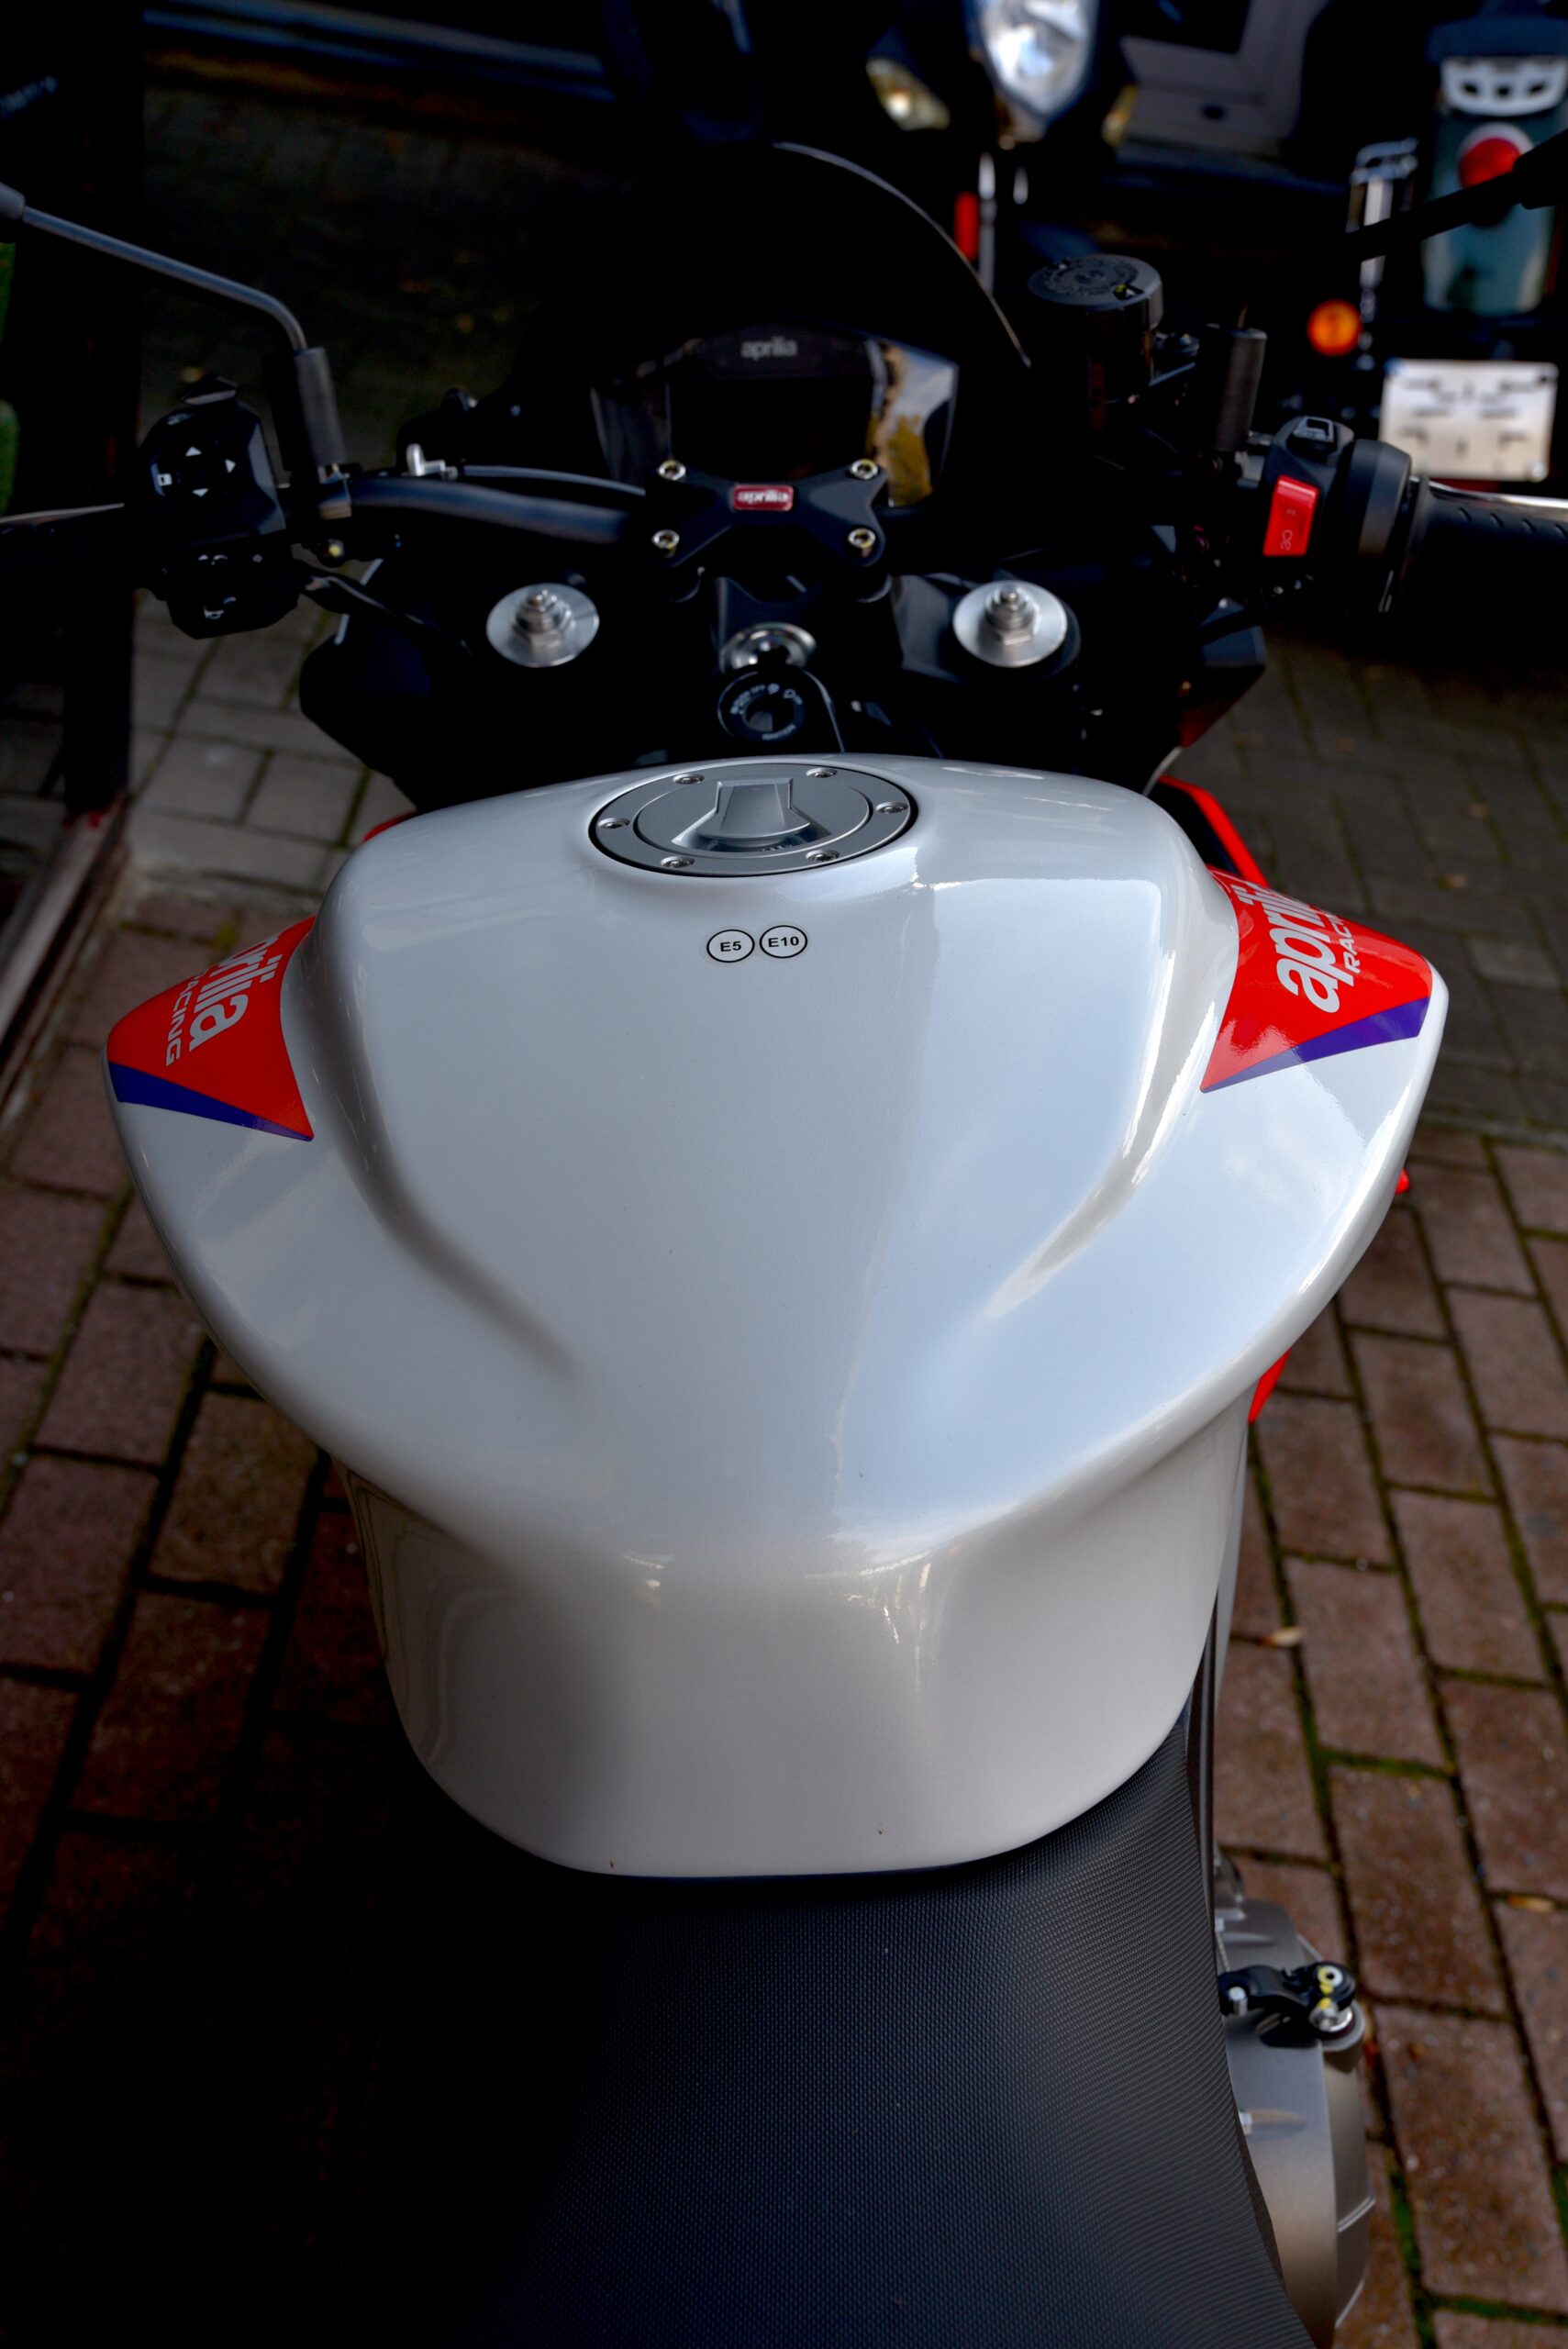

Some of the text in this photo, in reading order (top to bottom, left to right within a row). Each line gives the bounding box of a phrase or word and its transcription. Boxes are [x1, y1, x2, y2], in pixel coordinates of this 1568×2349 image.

[740, 337, 798, 362] aprilia
[738, 490, 789, 505] aprilia
[719, 941, 742, 952] E5
[768, 936, 799, 948] E10
[189, 935, 284, 1052] prilia
[165, 971, 206, 1066] ACING
